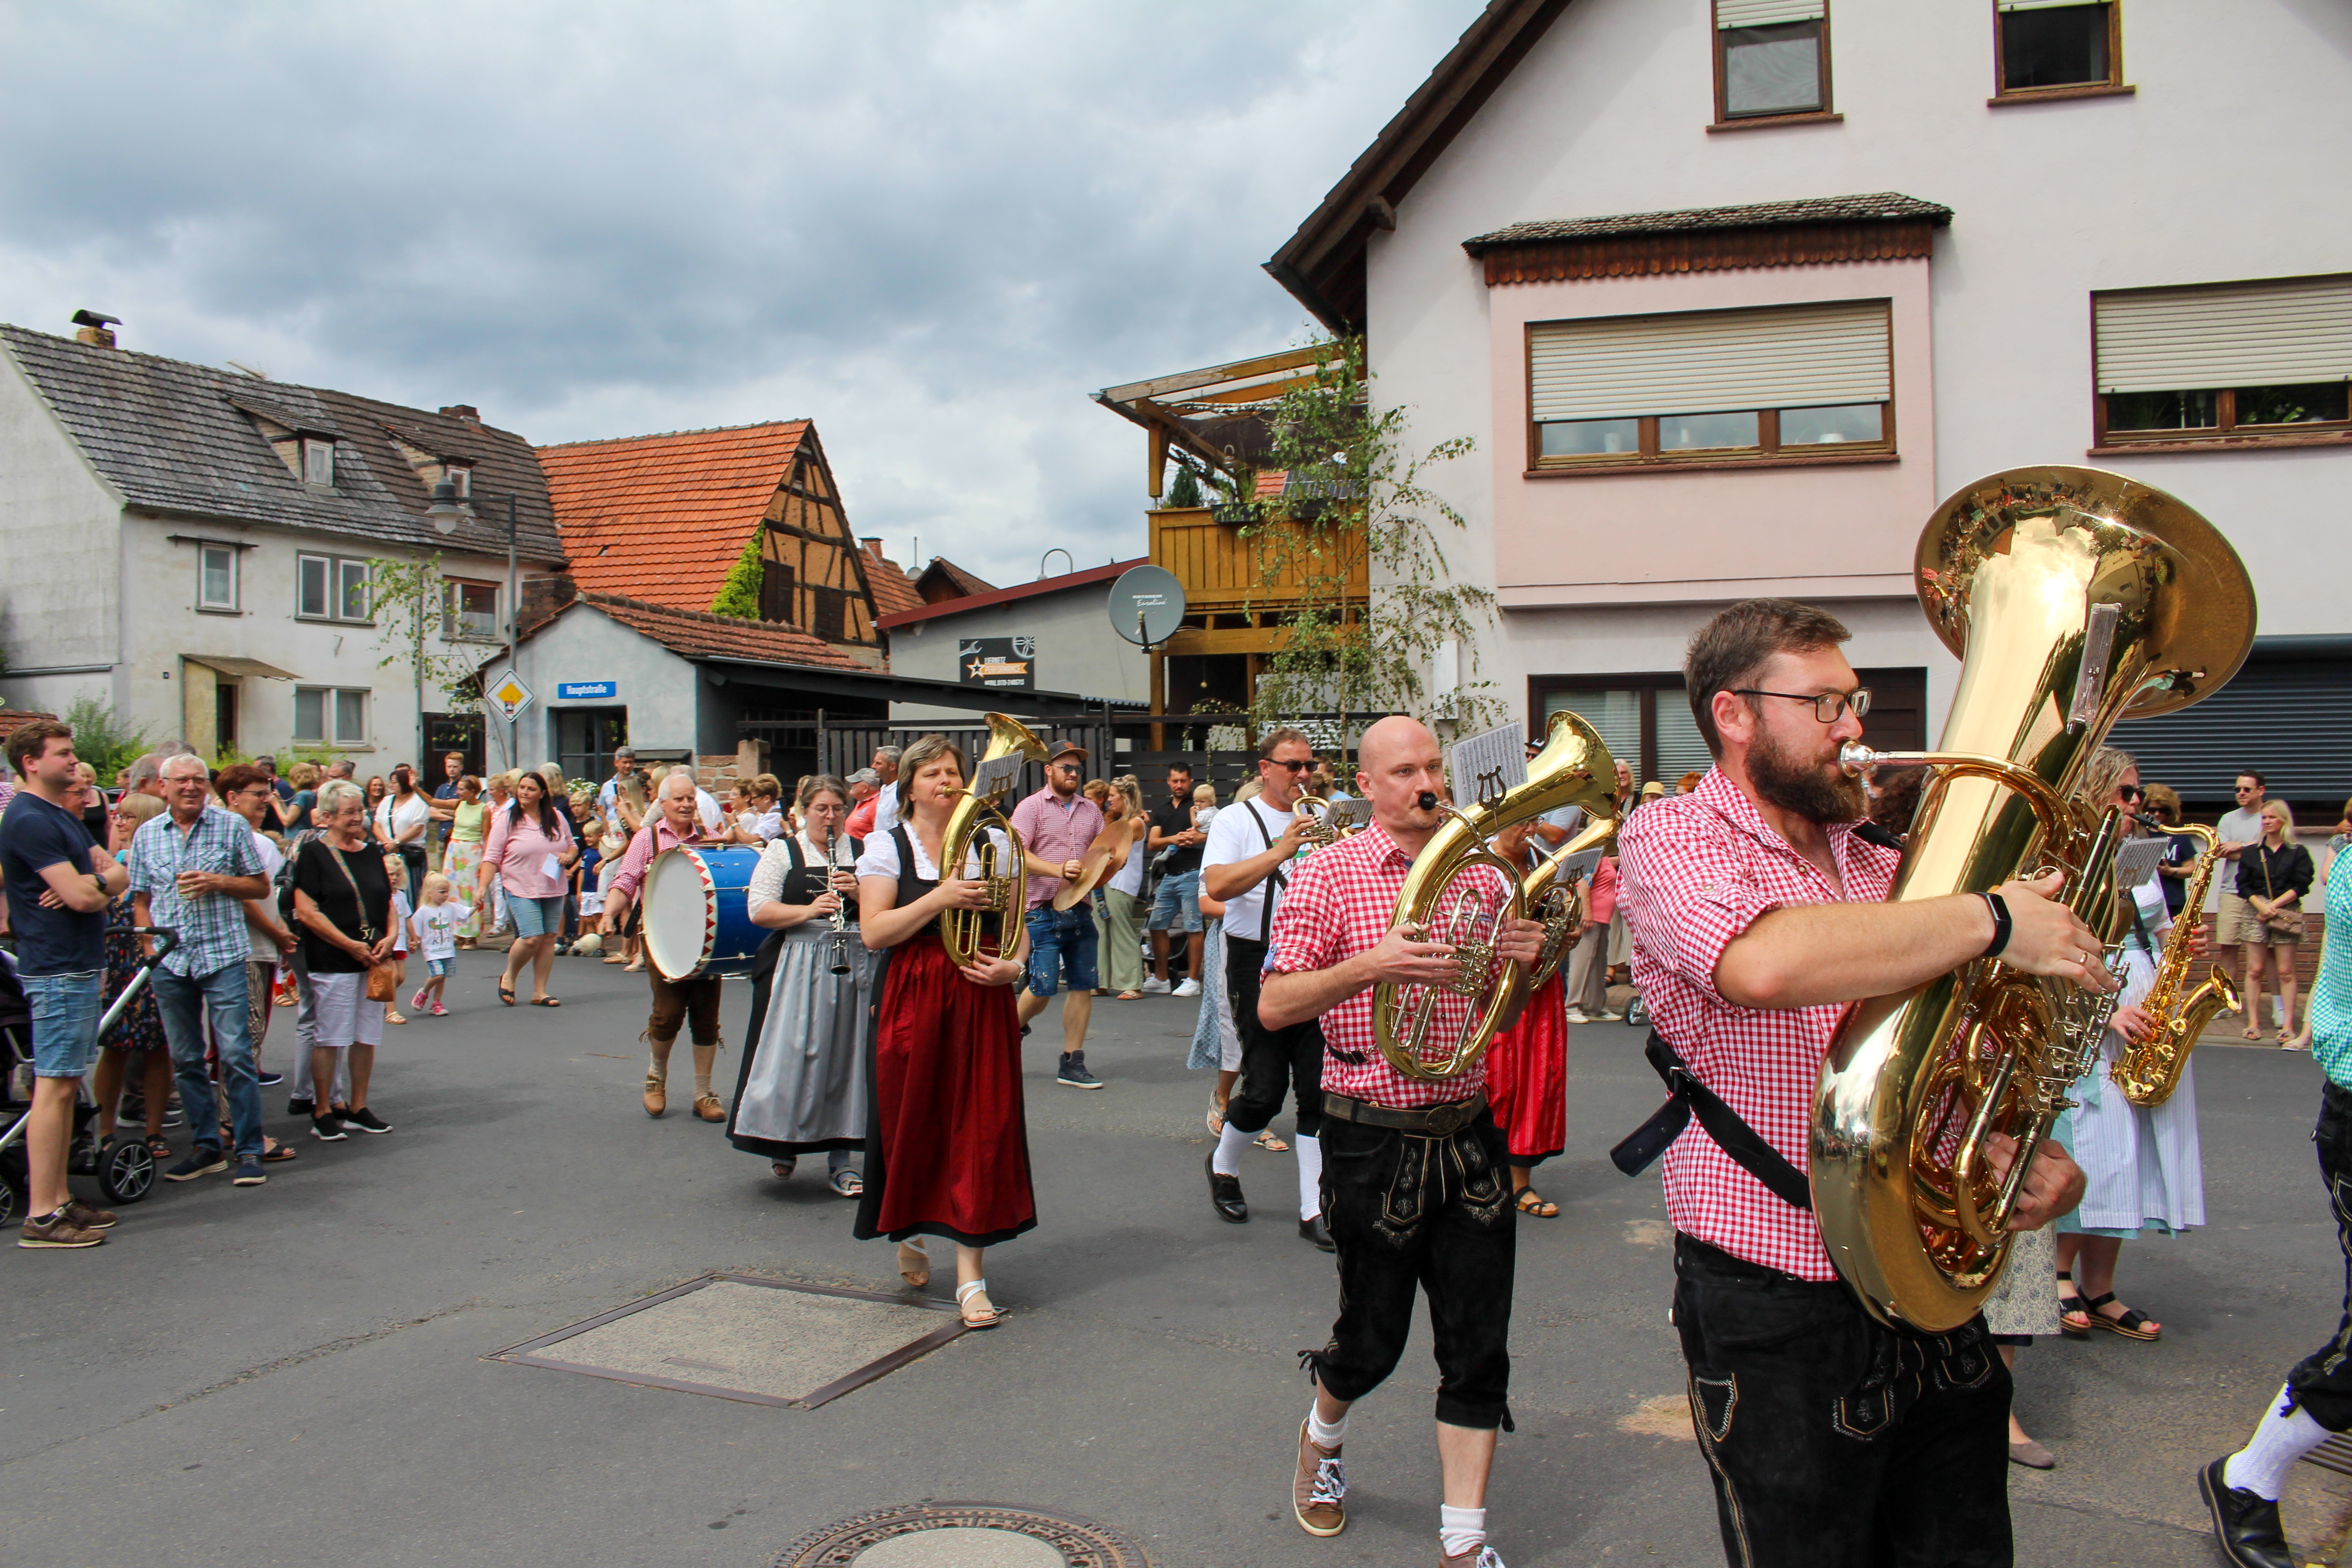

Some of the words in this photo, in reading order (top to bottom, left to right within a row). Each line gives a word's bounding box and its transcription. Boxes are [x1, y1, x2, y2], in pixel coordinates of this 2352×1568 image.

[1137, 598, 1166, 607] Euroline
[985, 665, 1020, 673] PERFORMANCE
[566, 684, 607, 696] Hauptstraße
